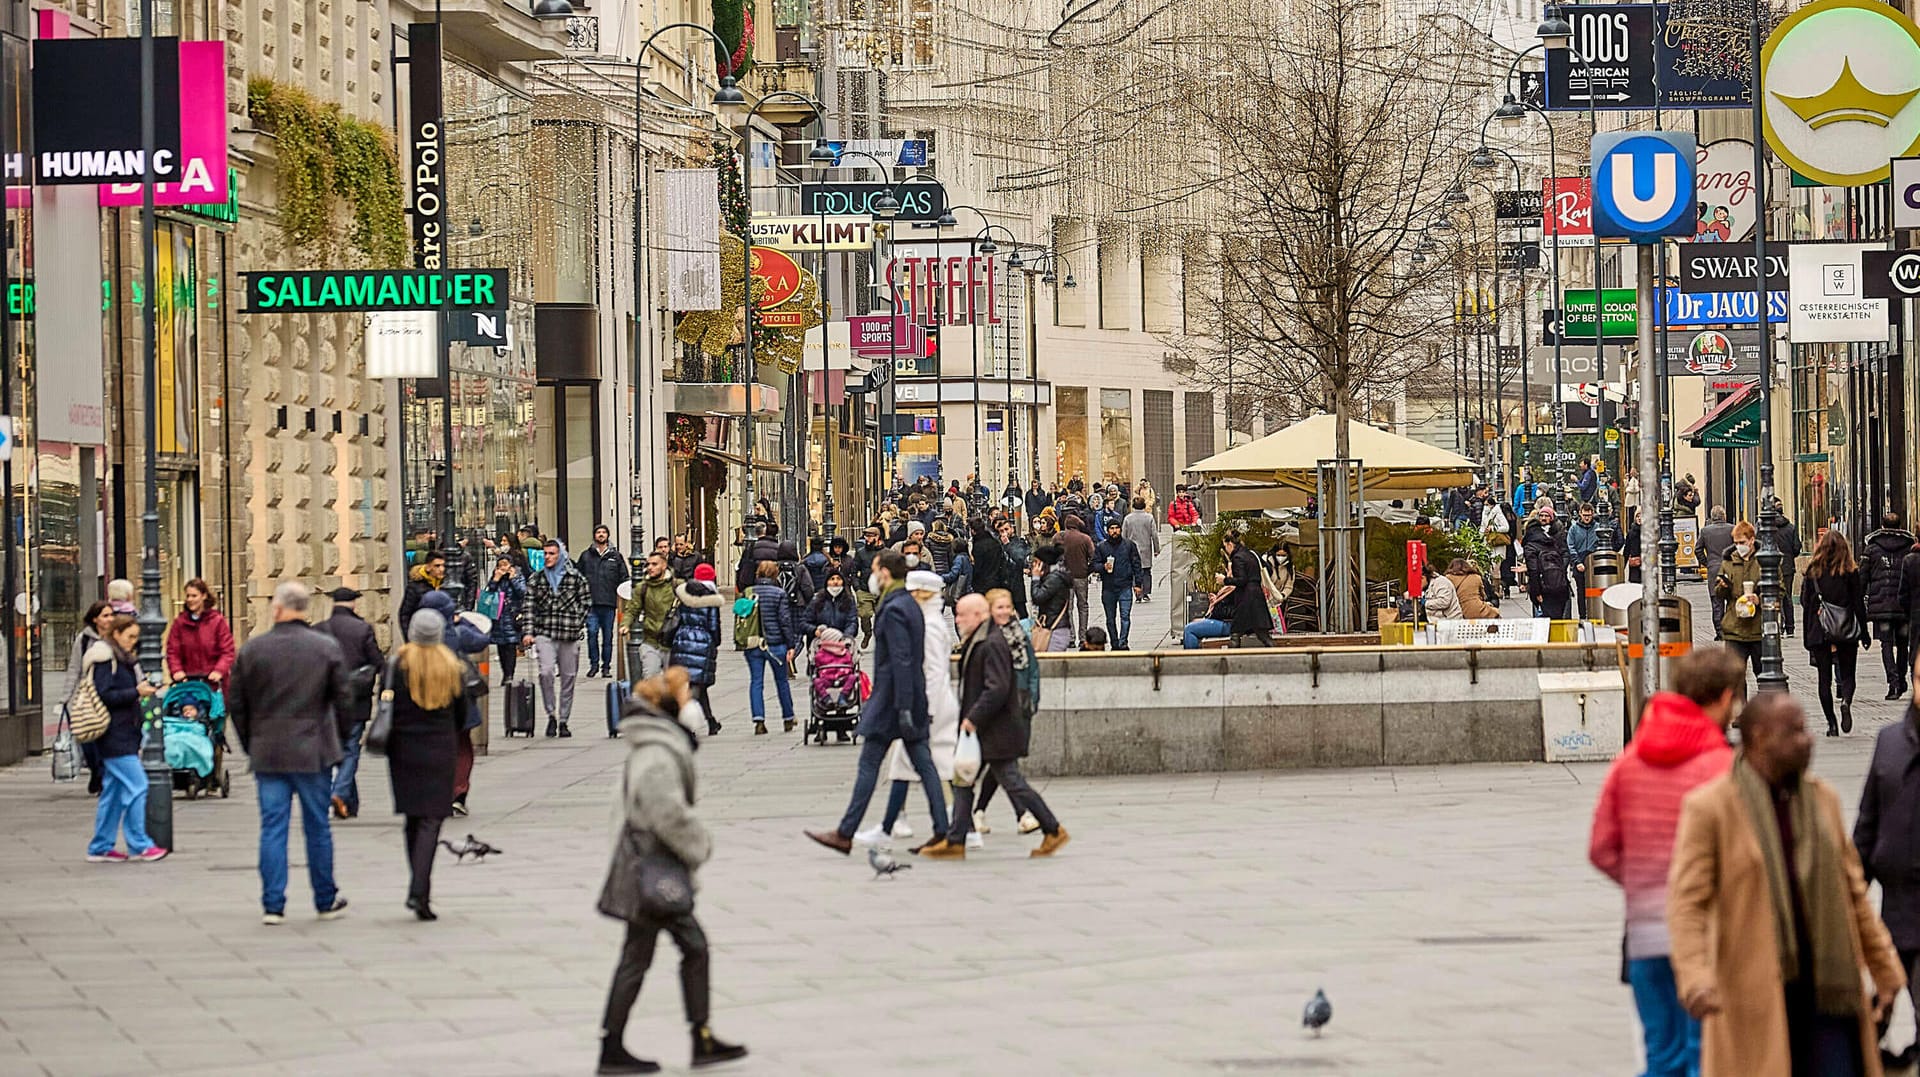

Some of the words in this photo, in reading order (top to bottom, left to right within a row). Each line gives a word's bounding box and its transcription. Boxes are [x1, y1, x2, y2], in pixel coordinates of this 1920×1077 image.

[1569, 13, 1629, 64] LOOS
[1569, 67, 1630, 78] AMERICAN
[1569, 79, 1630, 90] BAR
[42, 149, 174, 178] HUMANC
[1611, 153, 1676, 224] U
[1520, 197, 1542, 208] RA
[1546, 191, 1593, 229] Ray
[792, 222, 871, 244] KLIMT
[424, 222, 441, 270] arc
[1690, 255, 1790, 279] SWAROV
[257, 274, 495, 308] SALAMANDER
[885, 256, 1002, 325] STEFFL
[1833, 282, 1845, 290] W
[1566, 303, 1597, 312] UNITE
[1604, 303, 1637, 312] COLOR
[1677, 293, 1703, 320] Dr
[1707, 291, 1787, 319] JACOBS
[1808, 311, 1872, 321] WERKSTÆTTEN
[860, 321, 881, 332] 1000
[1566, 314, 1581, 324] OF
[861, 332, 892, 343] SPORTS
[1545, 356, 1609, 376] IQOS
